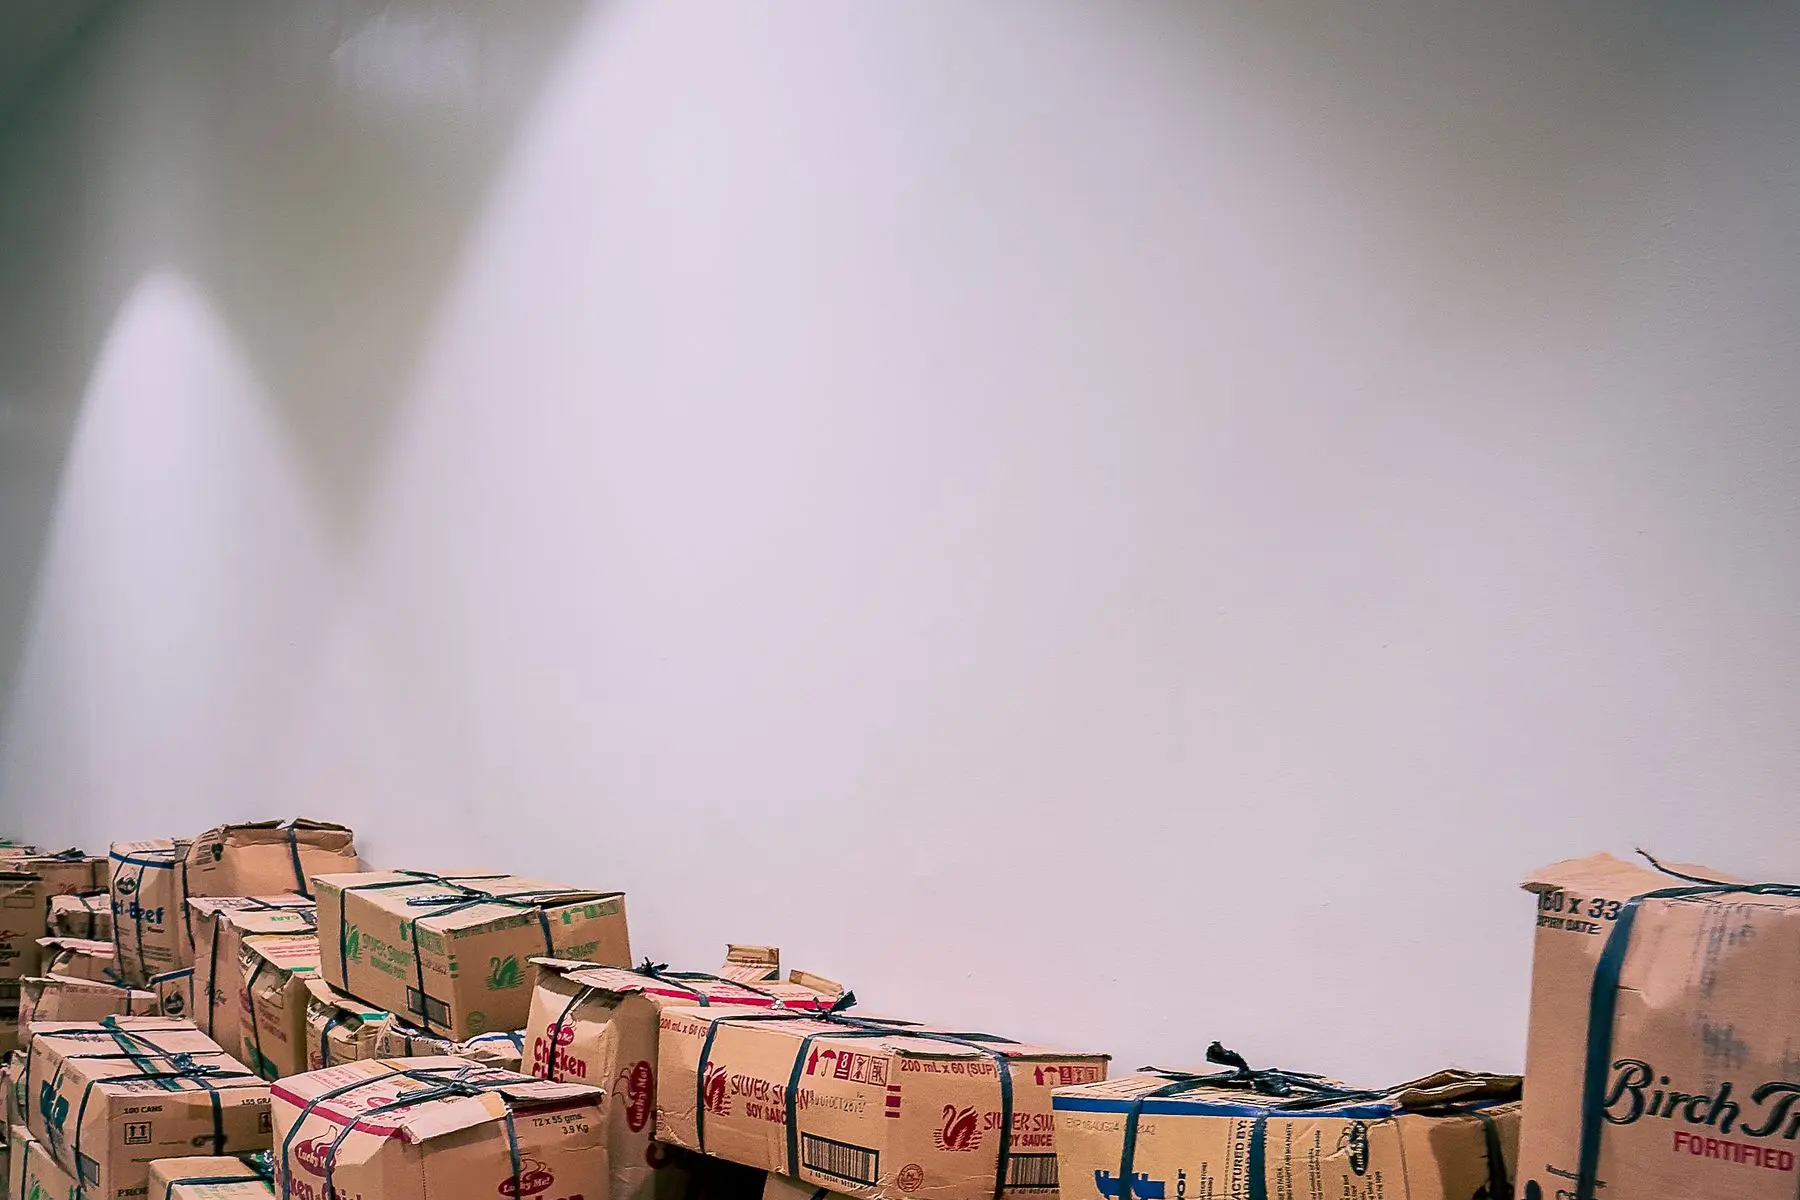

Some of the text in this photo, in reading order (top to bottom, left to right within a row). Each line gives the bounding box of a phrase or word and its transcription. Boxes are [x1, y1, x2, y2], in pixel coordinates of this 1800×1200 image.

[534, 1037, 586, 1078] Chcken
[901, 1059, 921, 1073] 200
[923, 1060, 942, 1074] mL
[951, 1062, 964, 1076] 60
[731, 1074, 769, 1102] SILVER
[772, 1083, 810, 1111] SWN
[1605, 1058, 1741, 1135] Birch
[533, 1117, 544, 1127] 72
[552, 1114, 563, 1125] 55
[746, 1102, 762, 1119] SOY
[562, 1123, 590, 1135] 3.9 Kg
[984, 1111, 1029, 1132] SILER
[1236, 1119, 1248, 1139] BY:
[1021, 1134, 1052, 1148] SAUCE
[1672, 1131, 1795, 1171] FORTIFIED
